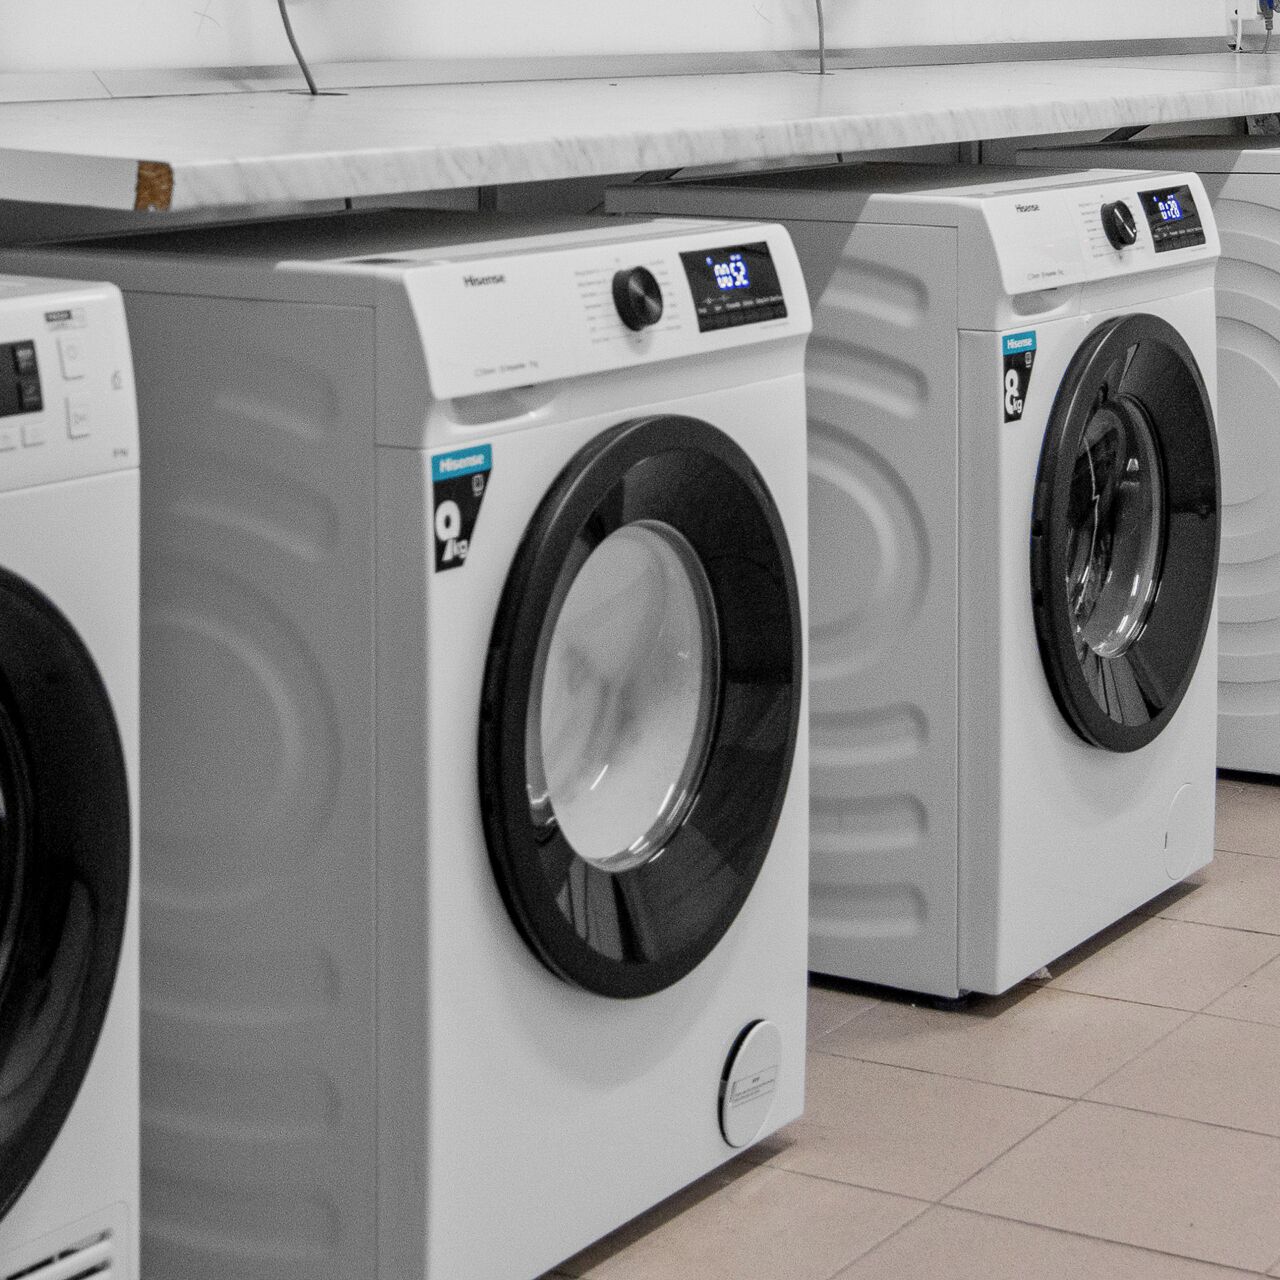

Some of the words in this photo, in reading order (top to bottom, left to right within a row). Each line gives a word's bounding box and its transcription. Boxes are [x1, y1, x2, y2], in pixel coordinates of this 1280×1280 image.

[463, 275, 506, 288] Hisense
[1007, 337, 1033, 350] Hisense
[440, 453, 485, 472] Hisense
